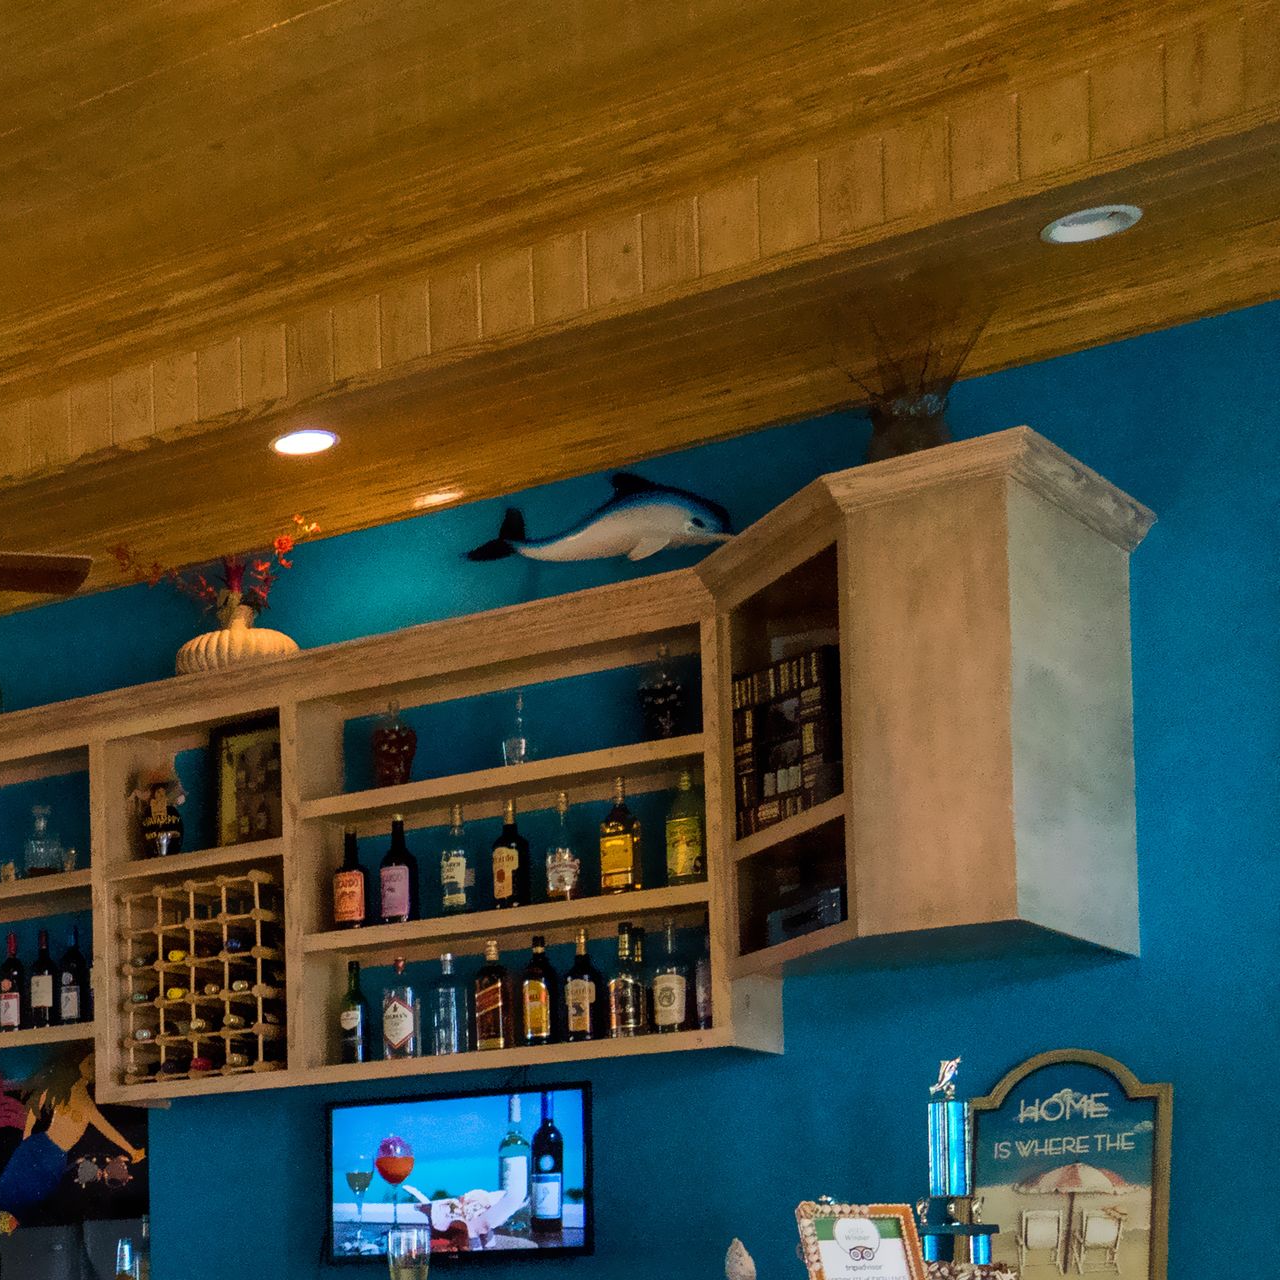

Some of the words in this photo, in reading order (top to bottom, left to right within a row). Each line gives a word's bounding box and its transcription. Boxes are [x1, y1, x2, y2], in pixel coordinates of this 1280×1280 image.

[1018, 1092, 1109, 1123] HOME
[994, 1141, 1011, 1159] IS
[1015, 1135, 1090, 1158] WHERE
[1094, 1132, 1136, 1152] THE
